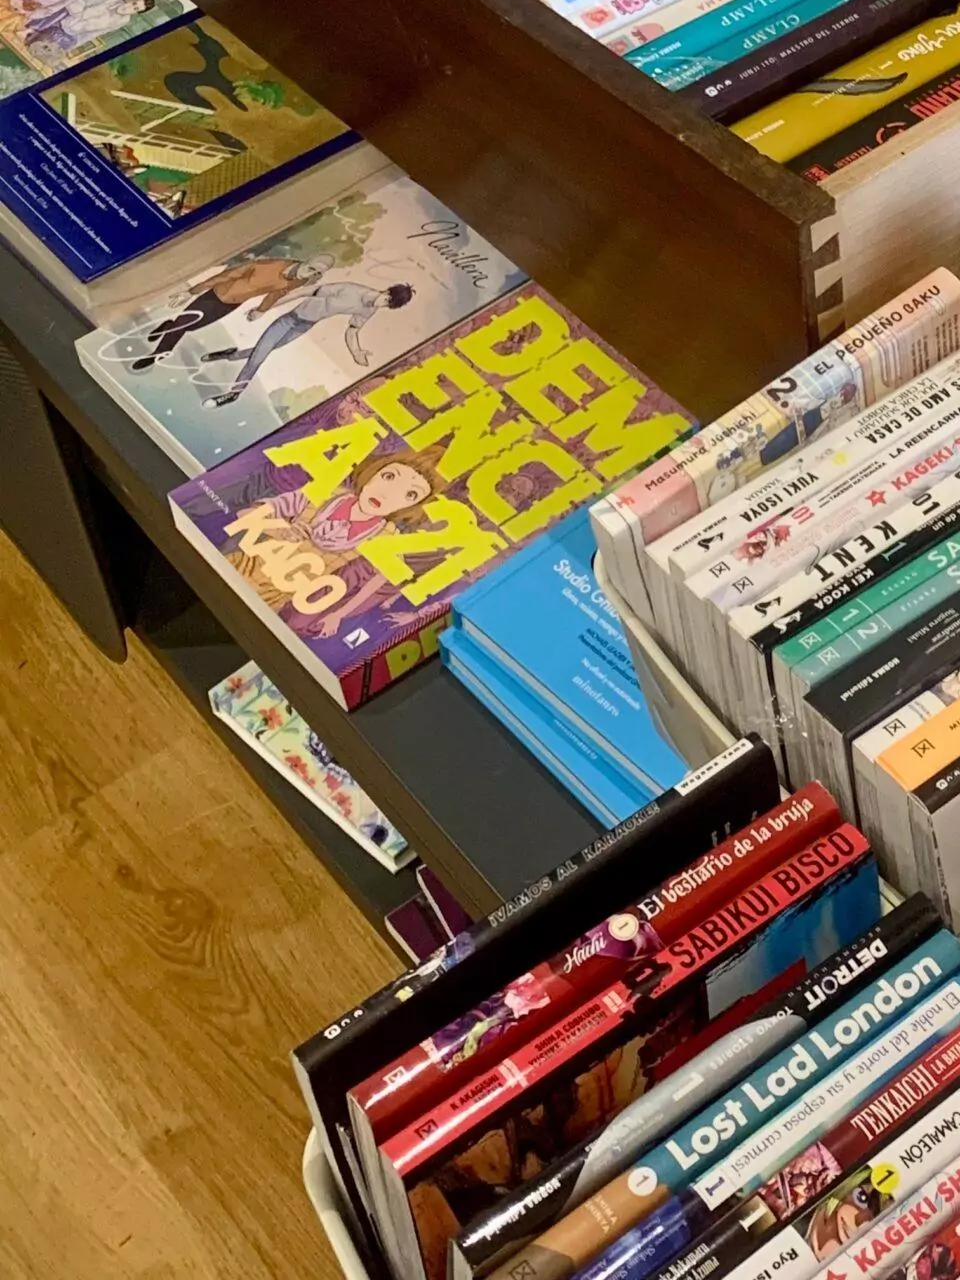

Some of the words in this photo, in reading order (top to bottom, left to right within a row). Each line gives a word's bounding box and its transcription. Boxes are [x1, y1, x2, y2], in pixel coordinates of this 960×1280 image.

[738, 64, 760, 80] JUNJI
[779, 36, 815, 59] MAESTRO
[815, 26, 832, 41] DEL
[831, 12, 861, 35] TERROR
[742, 13, 801, 50] CLAMP
[813, 359, 834, 376] EL
[836, 310, 905, 362] PEQUEÑO
[902, 284, 942, 319] BAKU
[644, 444, 708, 492] Masumura
[784, 470, 820, 501] YUKI
[738, 492, 779, 524] ISOYA
[222, 502, 348, 615] KAGO
[553, 558, 592, 596] Studio
[811, 523, 899, 583] KENT
[572, 674, 621, 718] minotauro
[636, 892, 660, 921] El
[660, 846, 733, 907] bestiario
[733, 835, 757, 860] de
[753, 822, 772, 846] la
[768, 795, 816, 838] bruja
[667, 884, 784, 971] SABIKUI
[777, 829, 856, 898] BISCO
[561, 932, 606, 974] Hachi
[801, 936, 891, 1014] DETROIT
[665, 1098, 749, 1173] Lost
[743, 1044, 820, 1117] Lad
[809, 953, 944, 1056] London
[850, 1061, 940, 1143] TENKAICHI
[929, 1058, 945, 1075] LA
[770, 1246, 799, 1273] Ryo
[852, 1197, 940, 1272] KAGEKI
